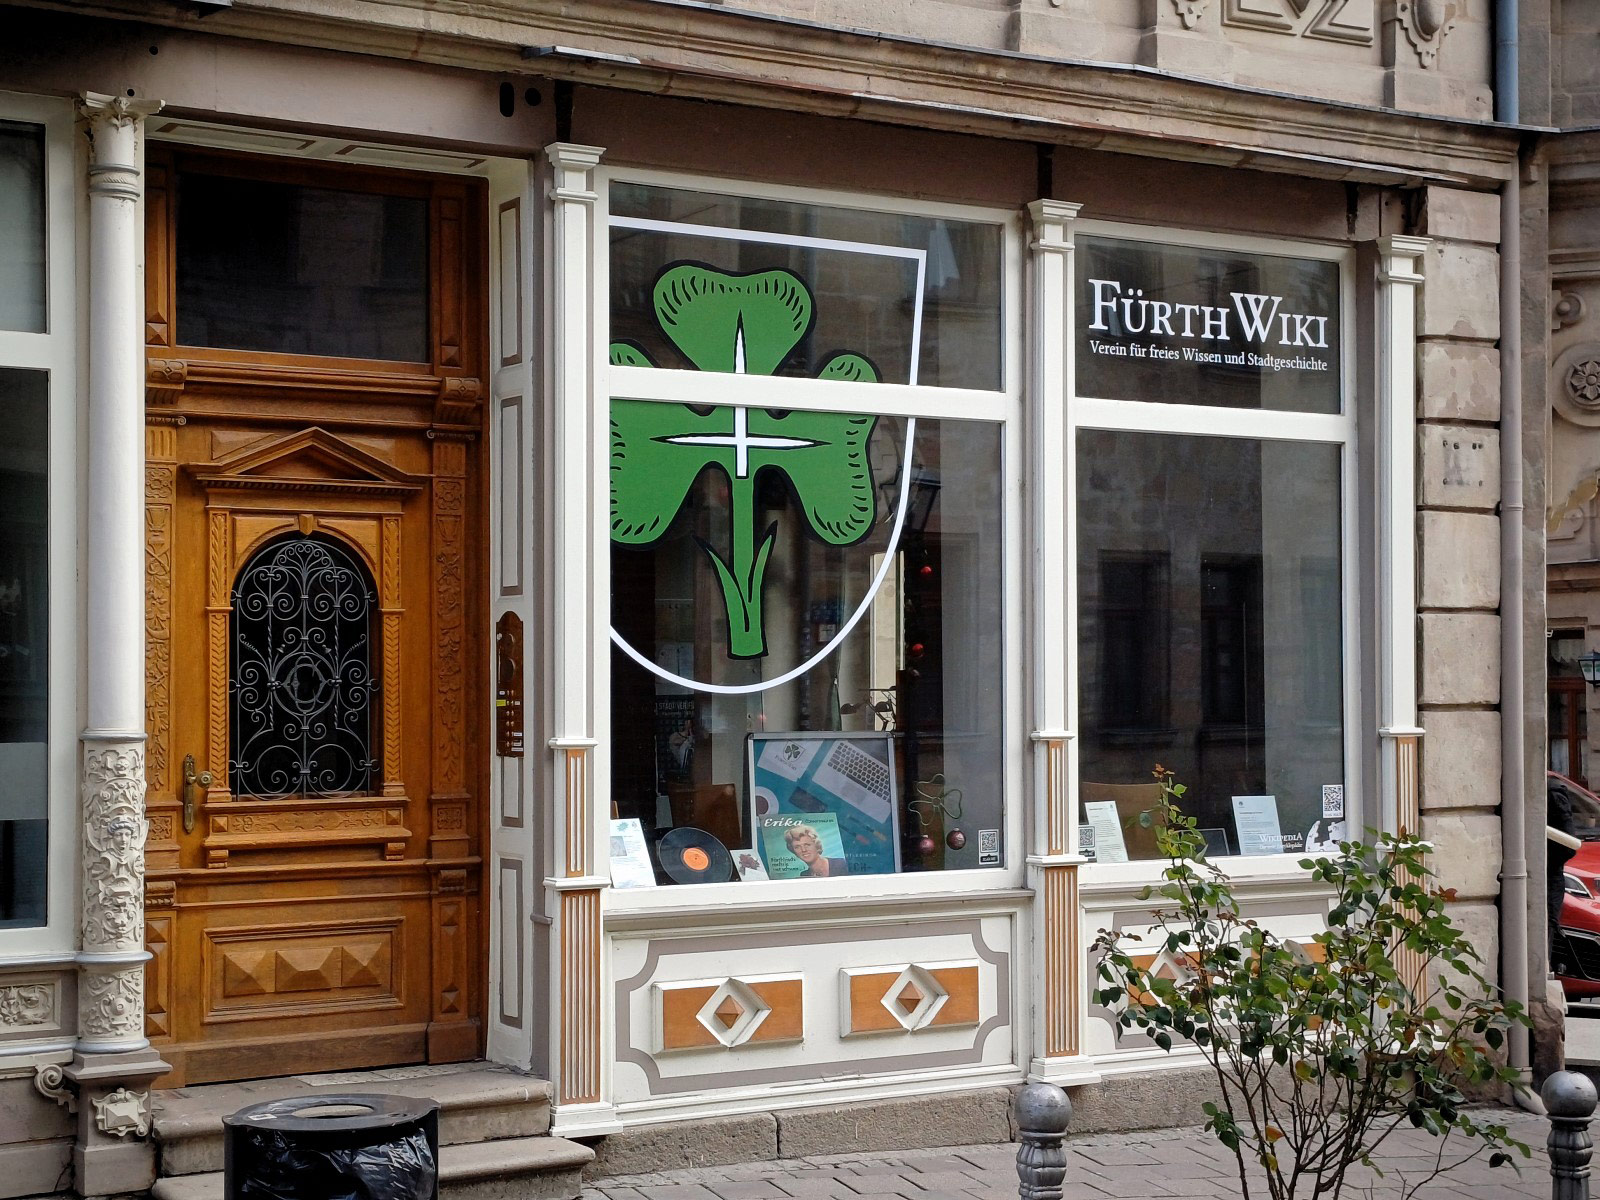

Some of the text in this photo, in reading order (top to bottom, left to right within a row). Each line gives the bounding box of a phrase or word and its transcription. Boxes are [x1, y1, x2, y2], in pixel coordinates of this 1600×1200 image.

[1089, 340, 1328, 372] Verein für freies Wissen und Stadtgeschichte
[764, 817, 803, 827] Erika
[1258, 832, 1303, 843] WIKIPEDIA
